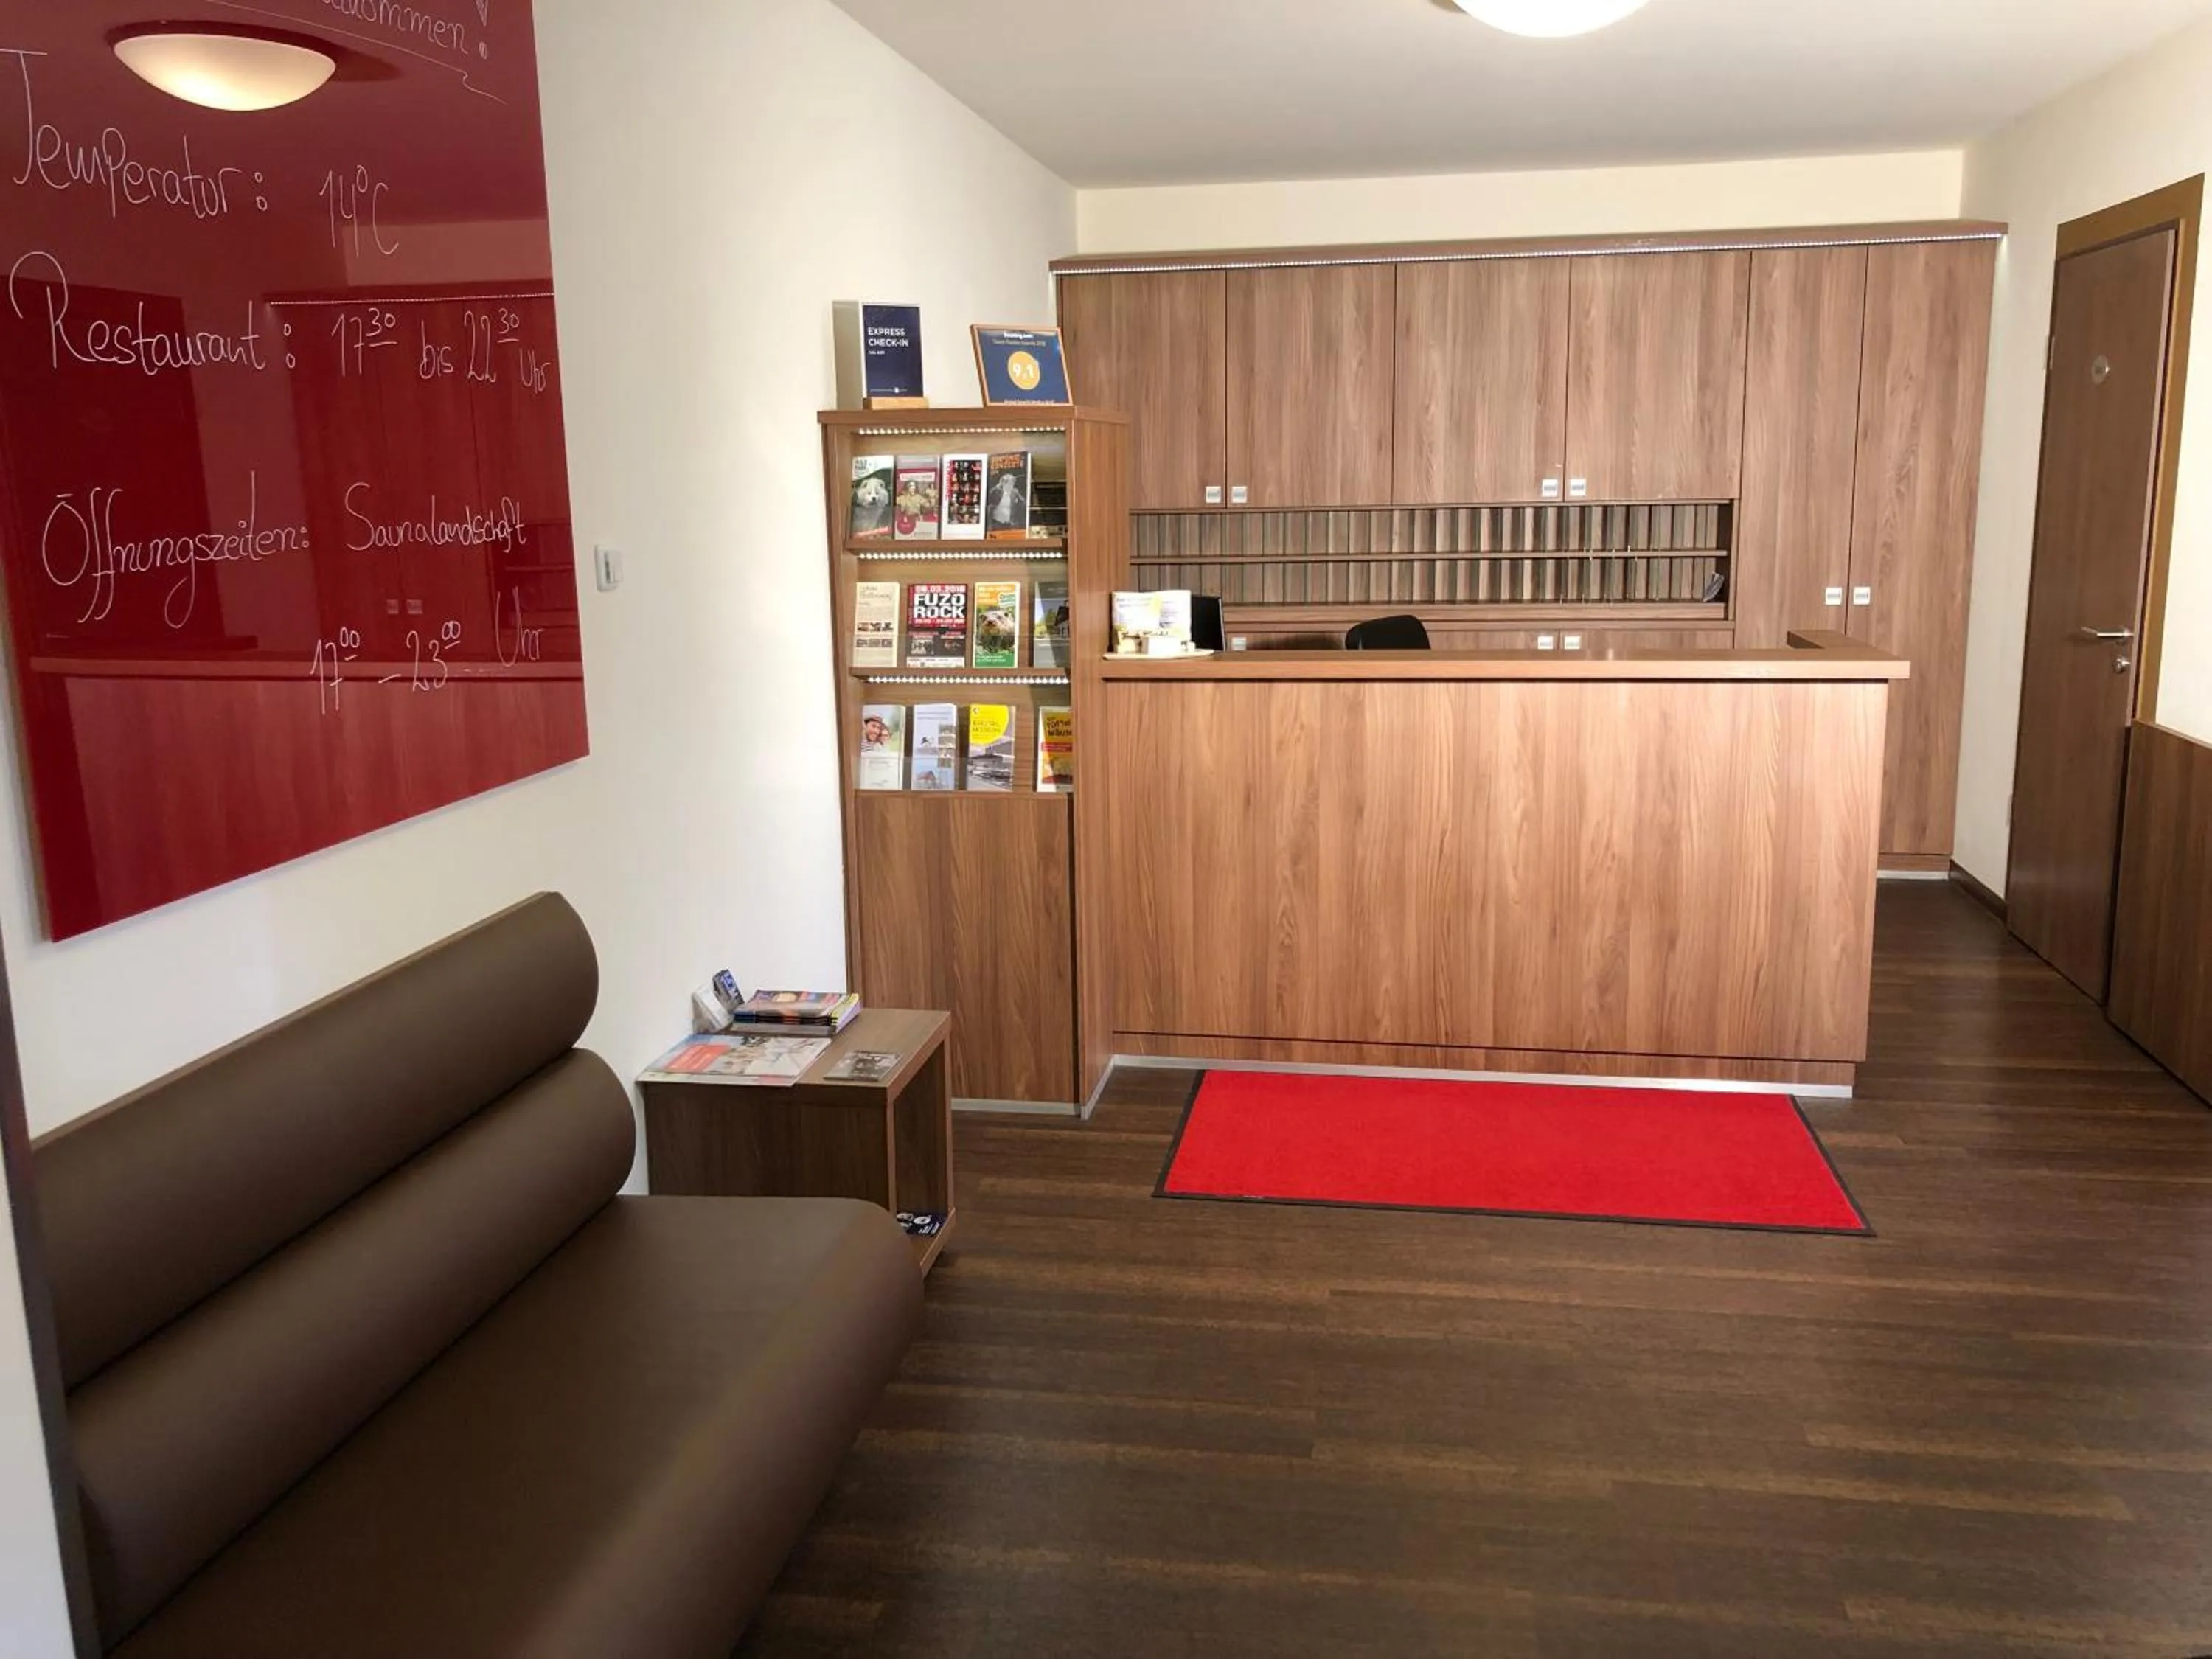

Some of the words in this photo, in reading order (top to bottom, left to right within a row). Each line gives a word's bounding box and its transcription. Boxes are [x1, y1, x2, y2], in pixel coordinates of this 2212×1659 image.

[867, 327, 906, 336] EXPRESS
[868, 338, 909, 347] CHECK-IN
[419, 319, 454, 380] bis
[519, 348, 552, 394] Uhr
[914, 593, 965, 606] FUZO
[914, 605, 965, 619] ROCK
